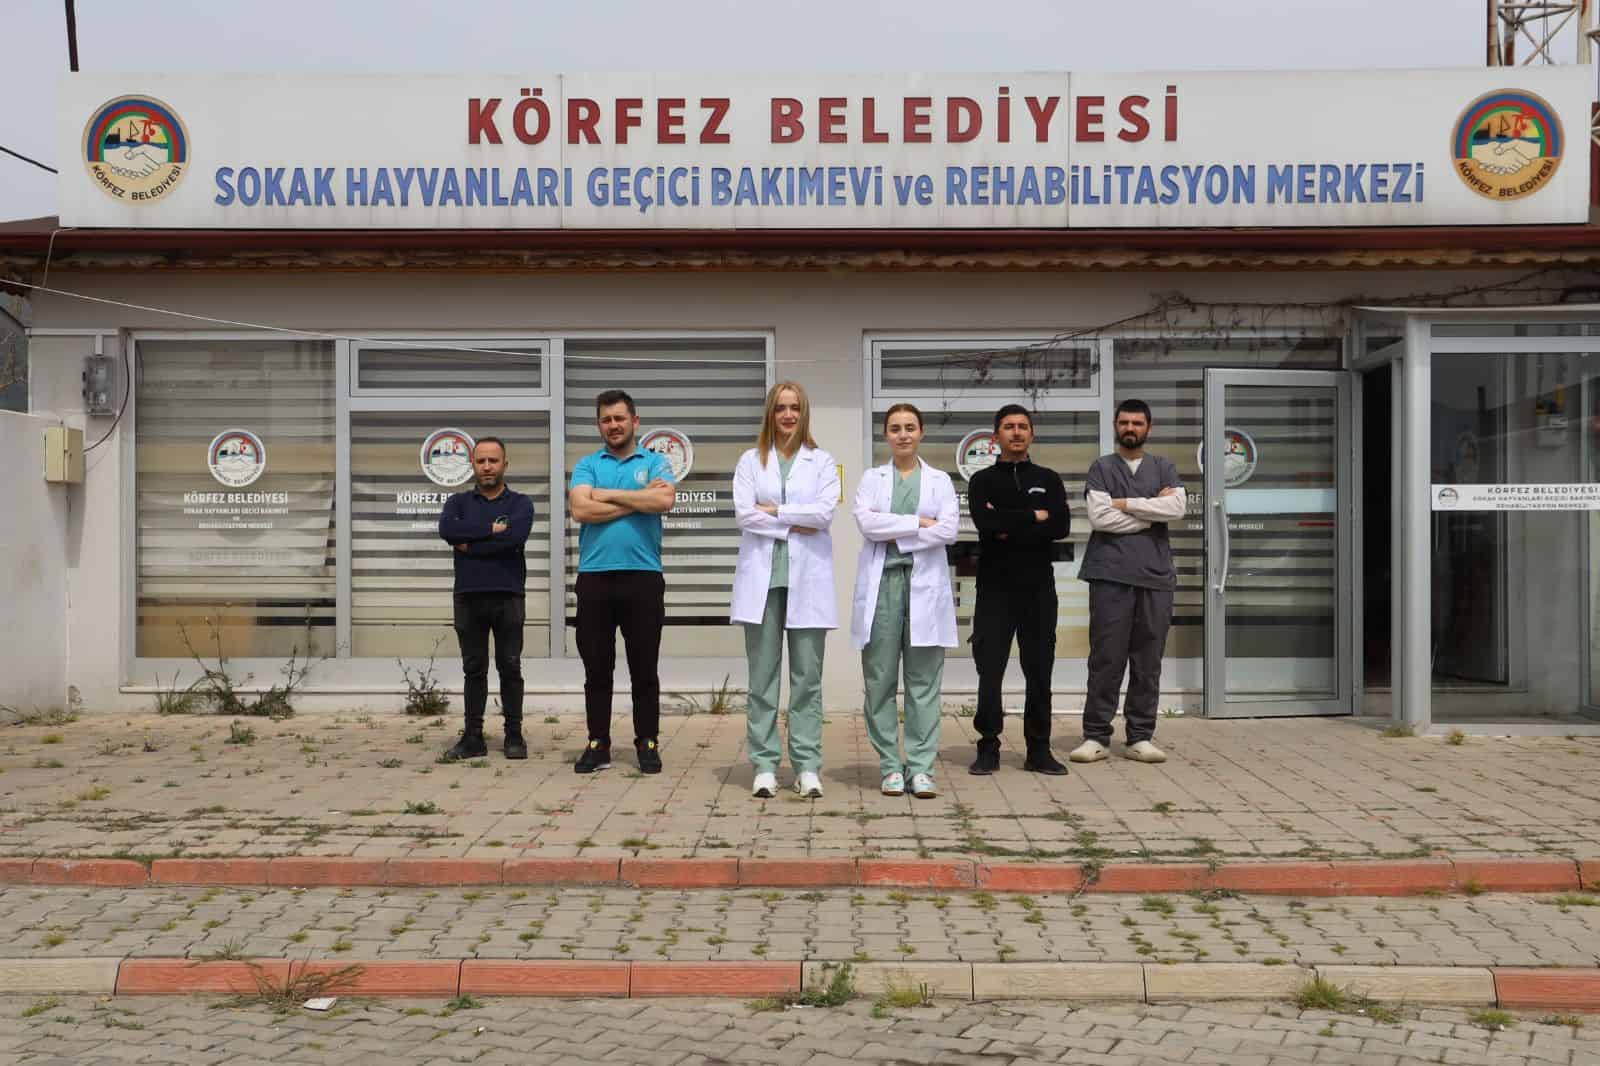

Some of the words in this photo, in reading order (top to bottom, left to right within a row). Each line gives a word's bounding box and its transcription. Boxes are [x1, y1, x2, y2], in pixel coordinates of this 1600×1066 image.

[468, 88, 730, 145] KÖRFEZ
[771, 86, 1178, 145] BELEDİYESİ
[215, 166, 335, 206] SOKAK
[346, 166, 573, 206] HAYVANLARI
[894, 174, 934, 206] ve
